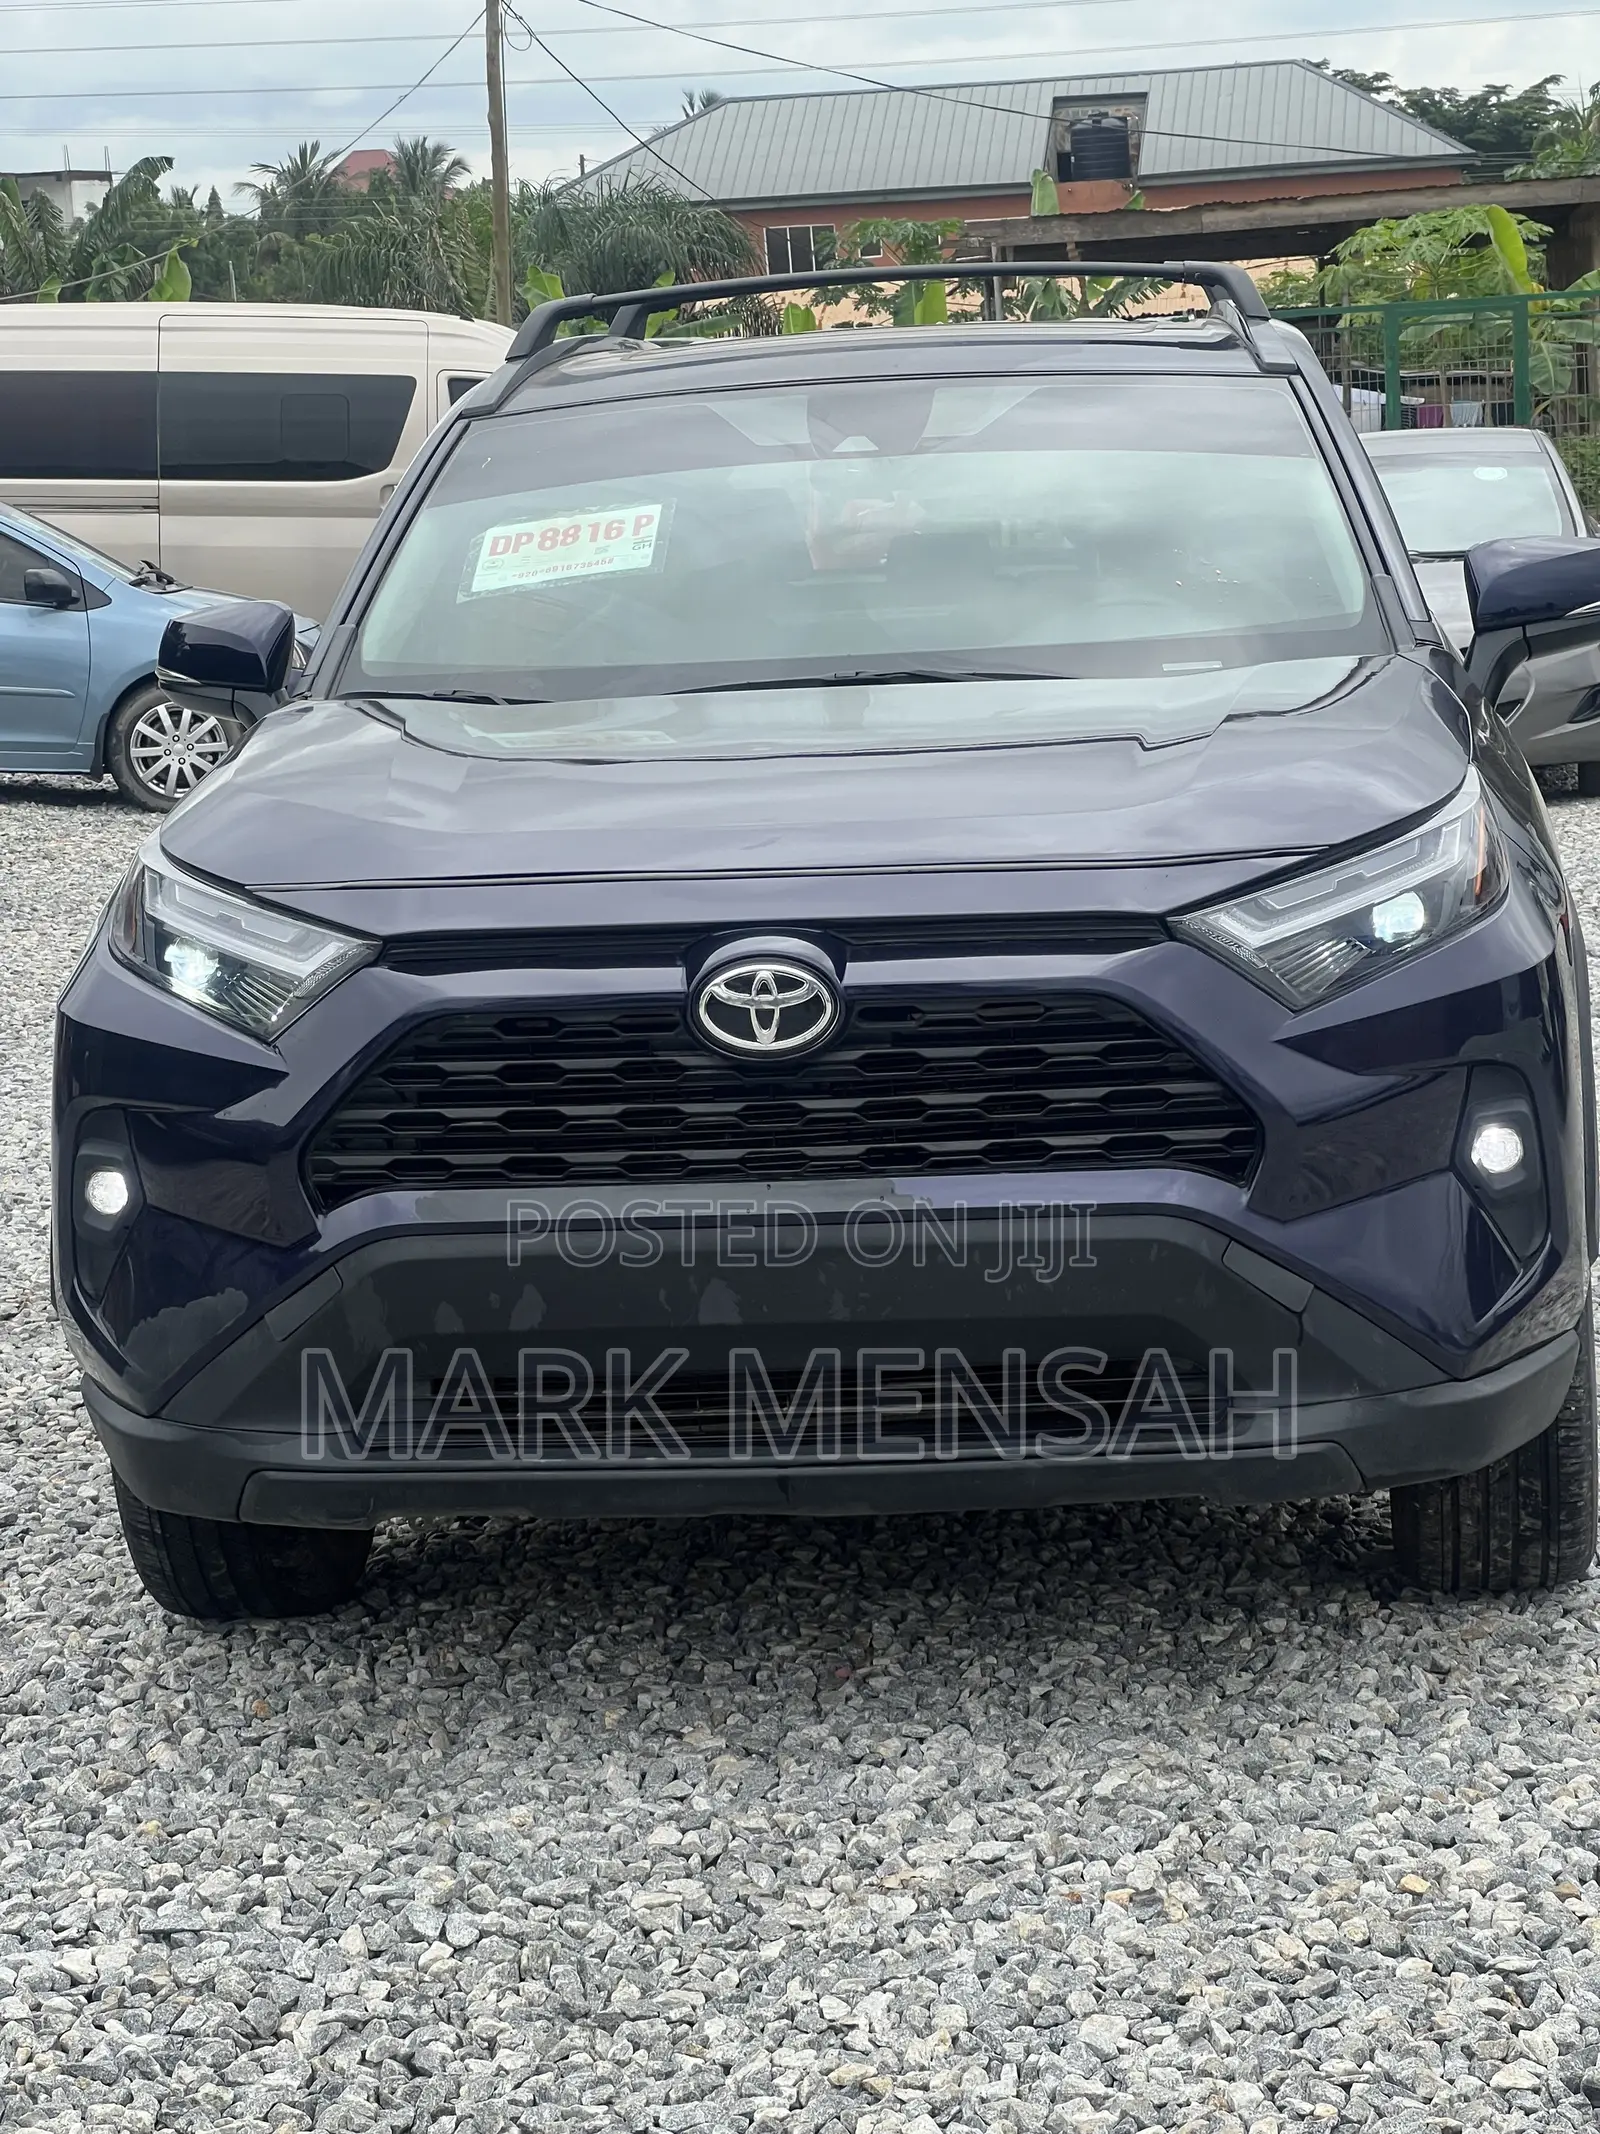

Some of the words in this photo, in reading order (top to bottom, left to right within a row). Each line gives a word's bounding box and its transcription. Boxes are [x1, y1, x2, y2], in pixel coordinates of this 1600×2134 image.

[488, 531, 535, 557] DP
[537, 519, 626, 552] 8816
[632, 514, 655, 537] P
[631, 542, 653, 551] GH
